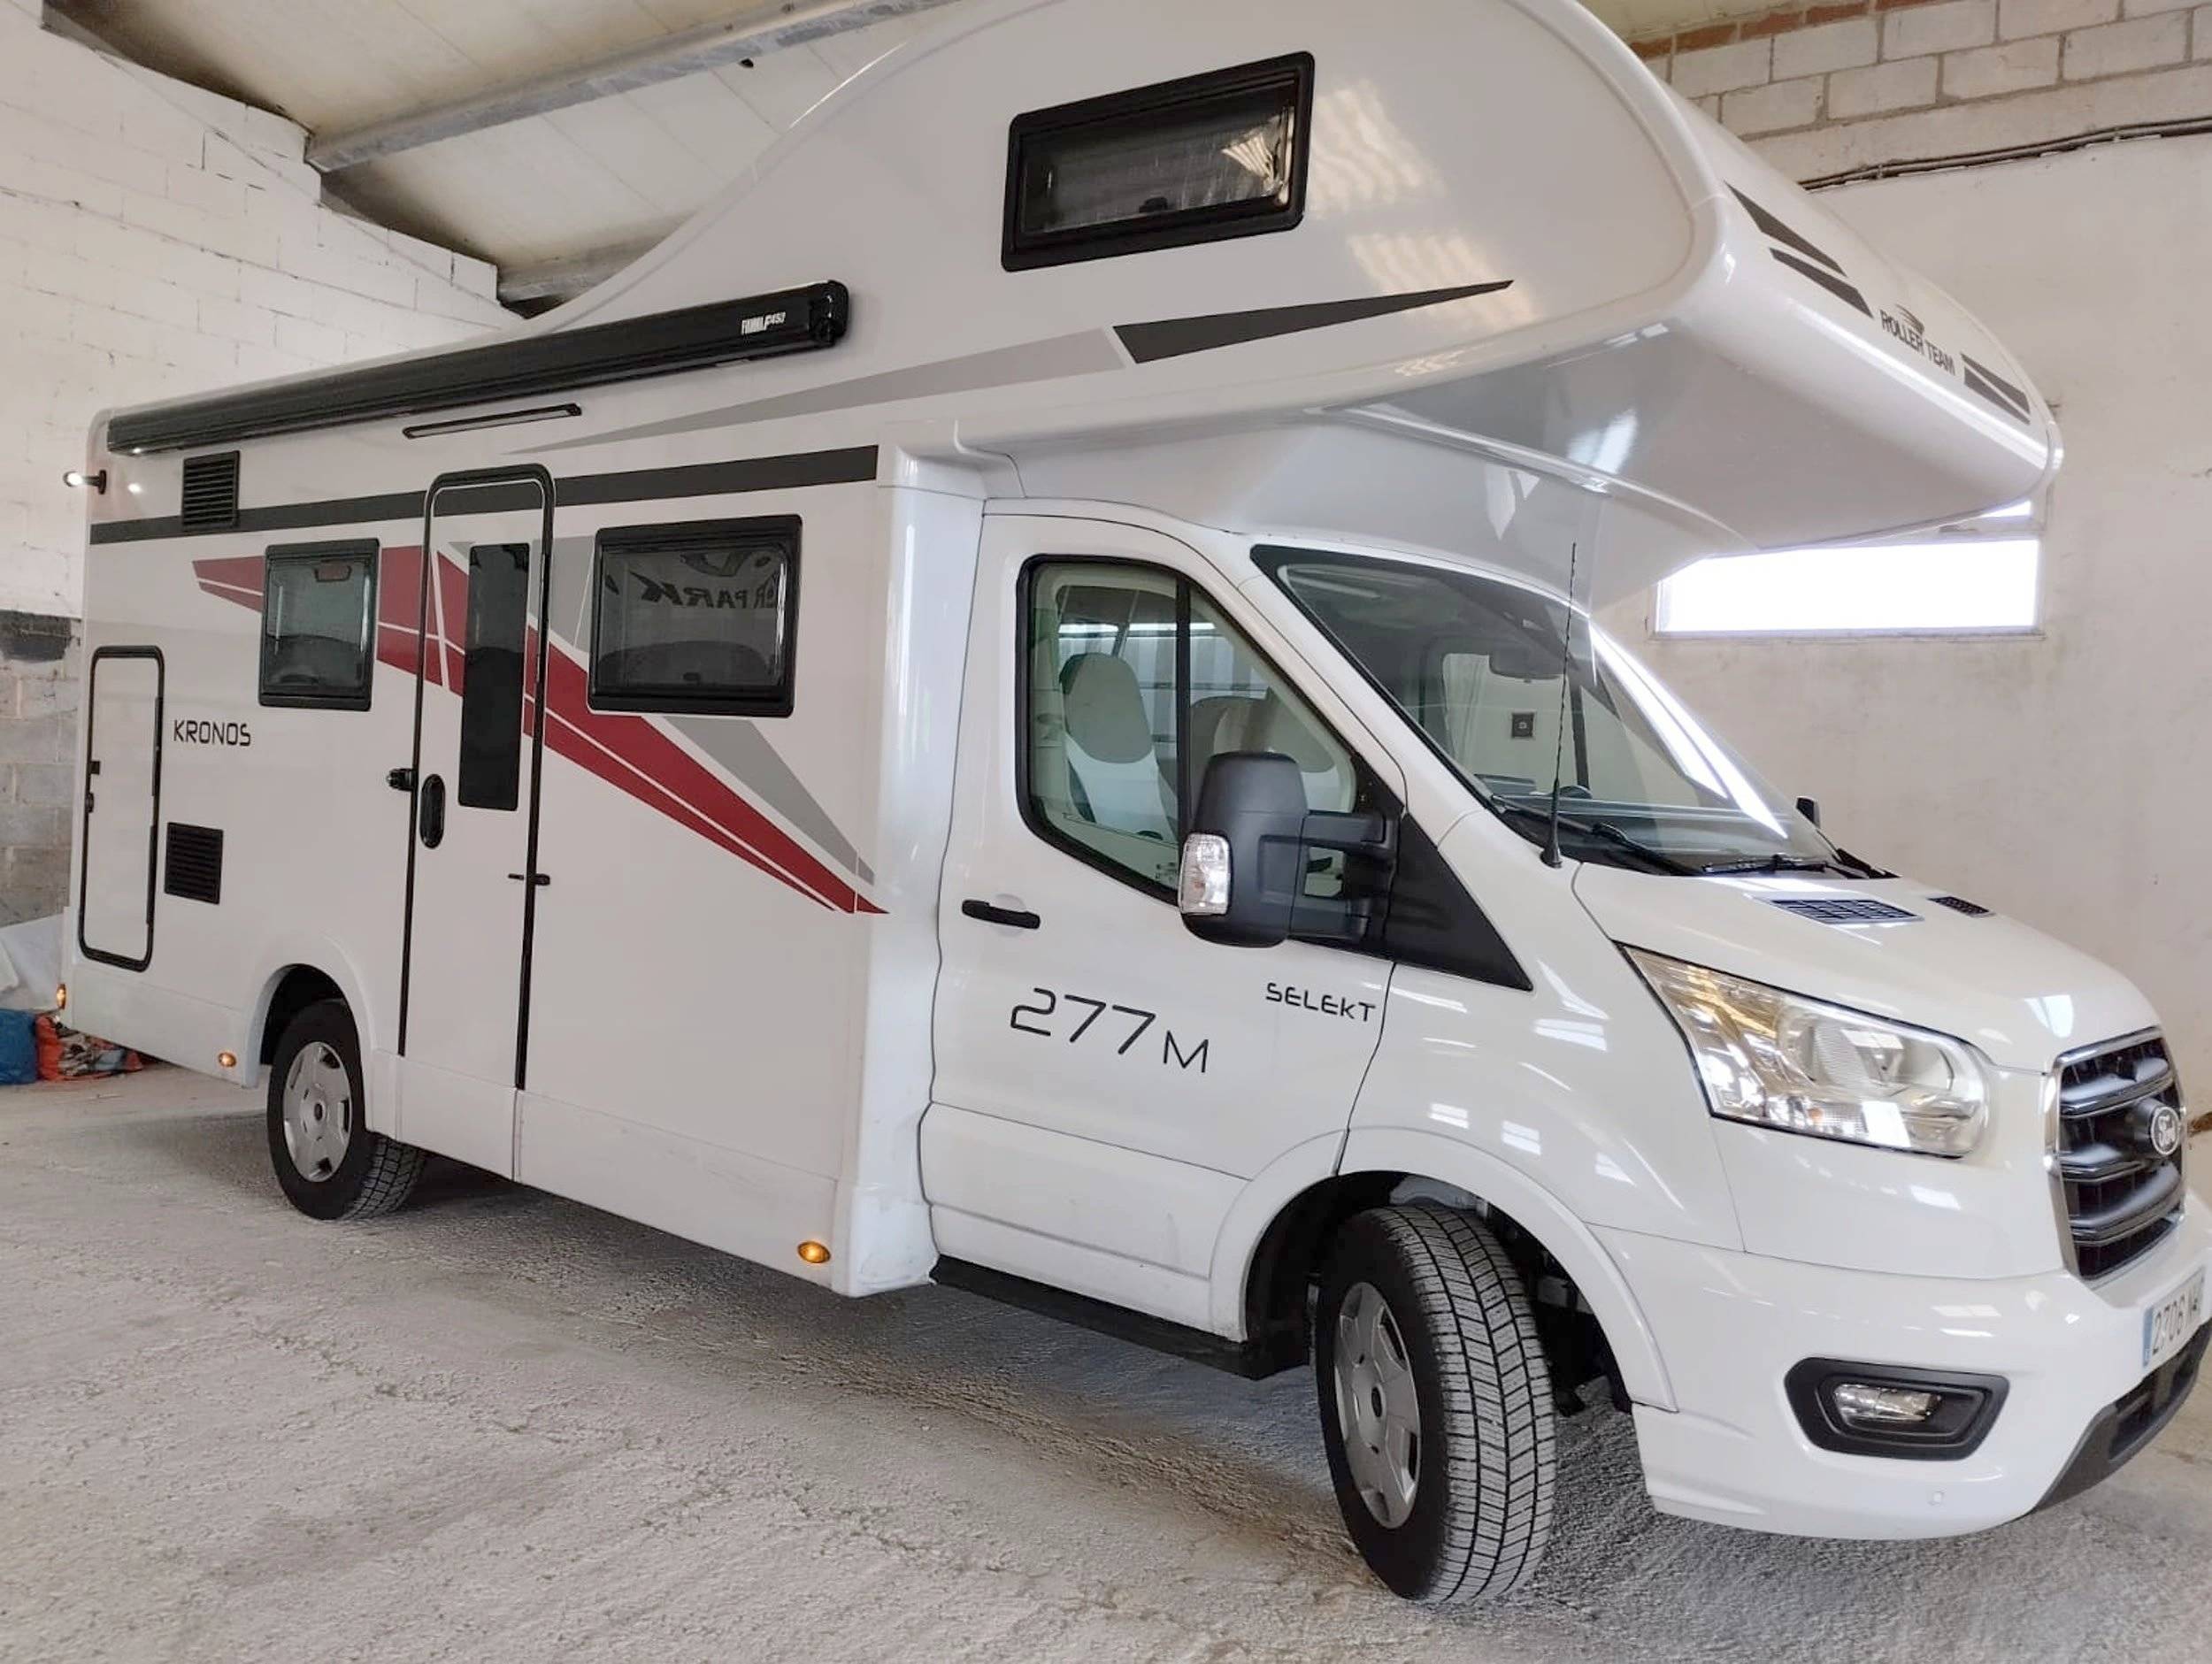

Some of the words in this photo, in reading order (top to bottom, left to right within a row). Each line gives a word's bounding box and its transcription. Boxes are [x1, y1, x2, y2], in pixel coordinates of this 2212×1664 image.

[1879, 309, 1924, 355] ROLLER
[1925, 340, 1956, 376] TEAM
[173, 719, 251, 747] KRONOS
[1264, 982, 1377, 1023] SELEKT
[2152, 1294, 2185, 1355] 2706
